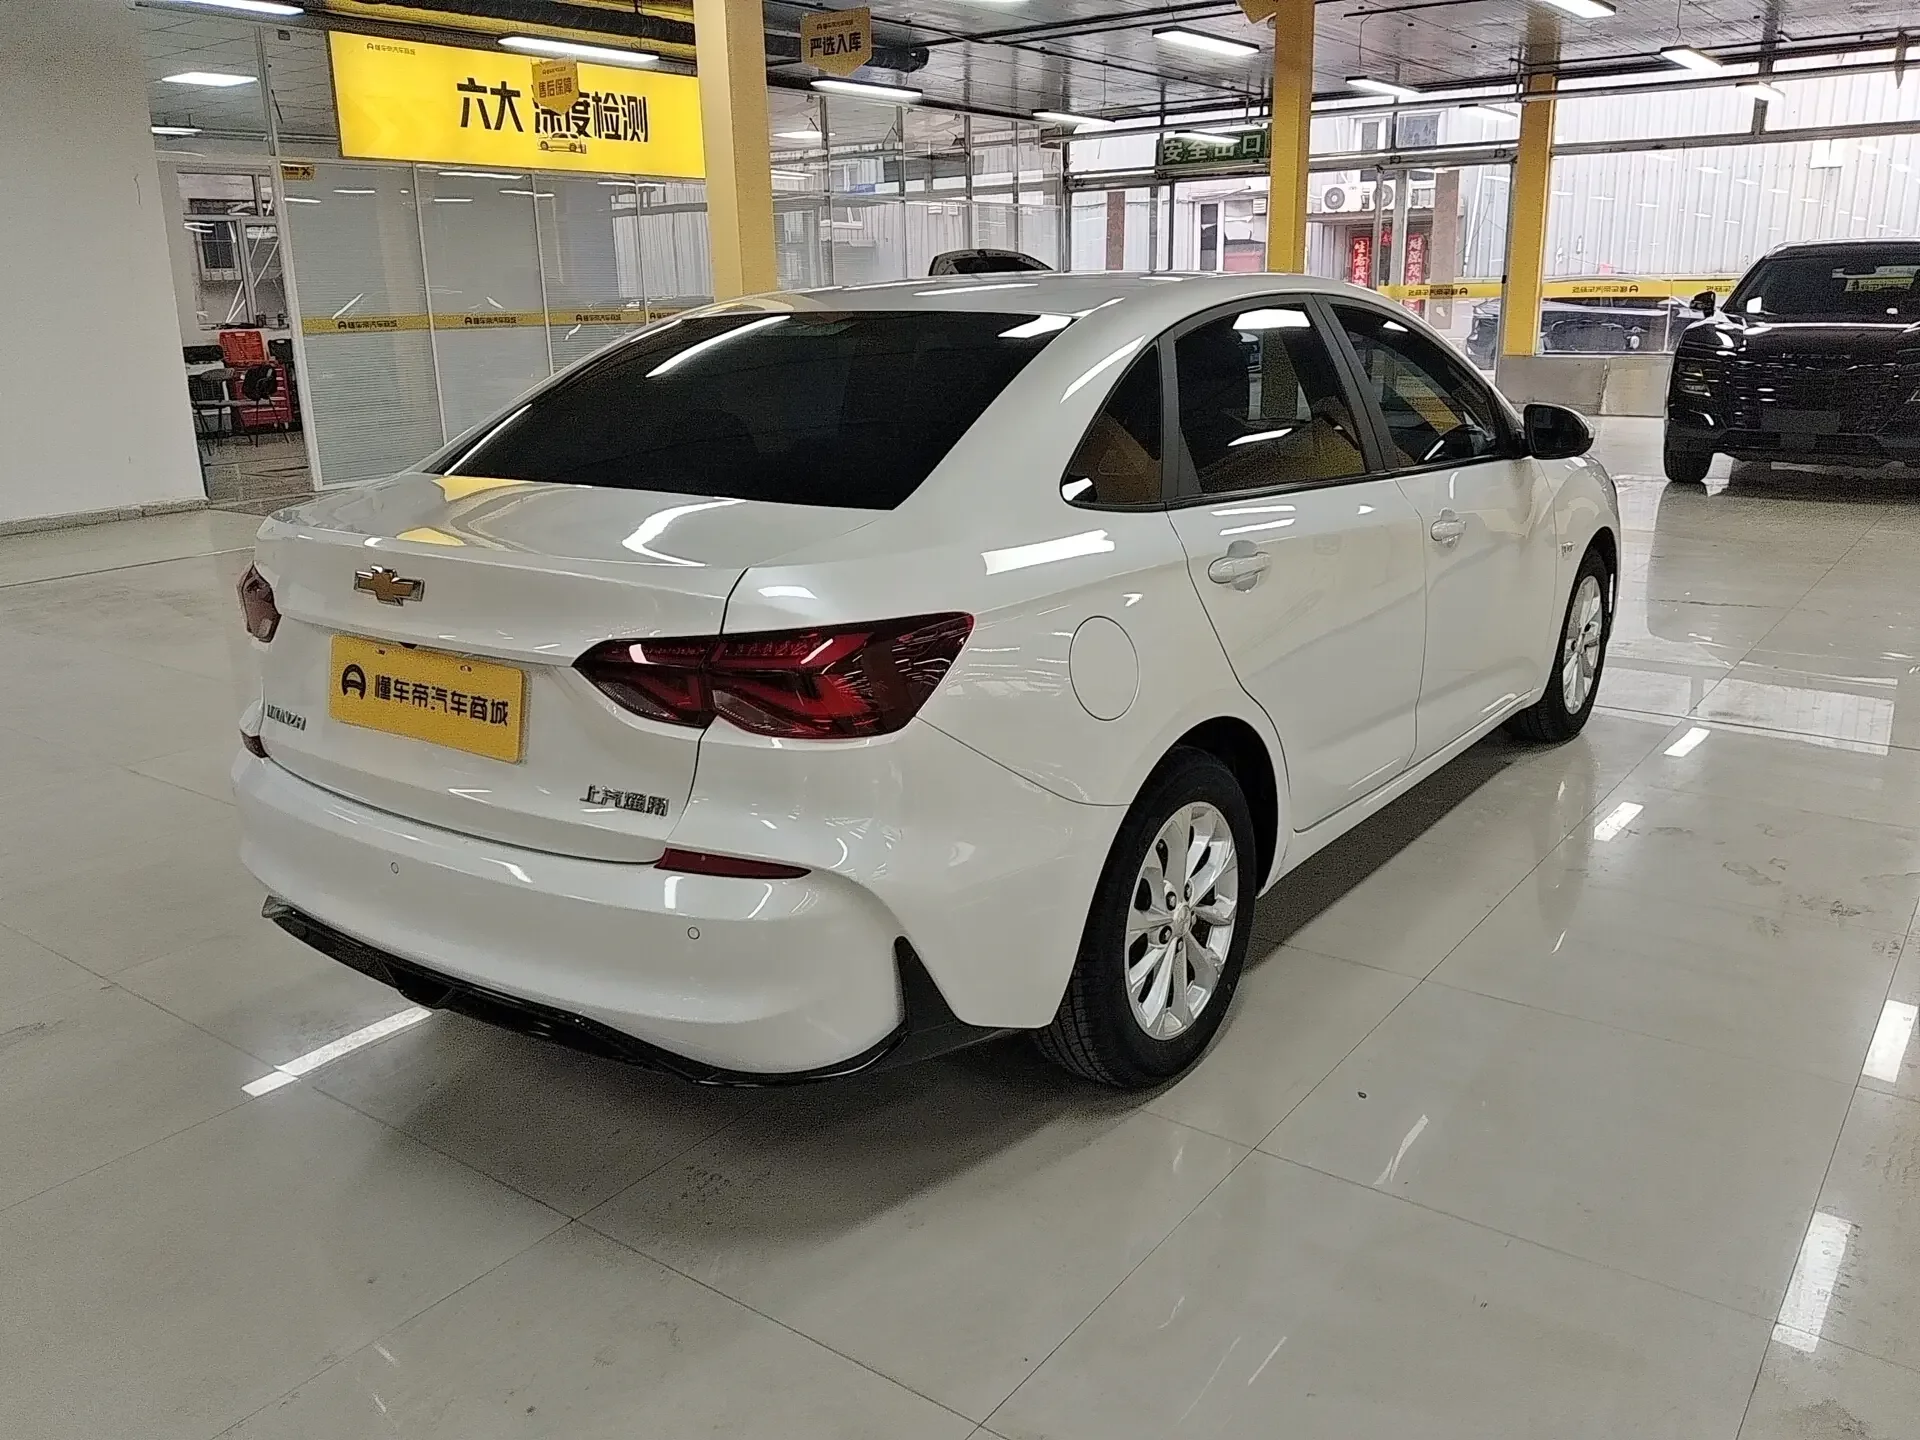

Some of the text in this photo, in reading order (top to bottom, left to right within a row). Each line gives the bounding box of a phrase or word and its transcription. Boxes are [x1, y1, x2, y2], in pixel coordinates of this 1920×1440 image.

[809, 31, 862, 58] 严选入库
[538, 77, 573, 98] 售后保障
[1164, 134, 1261, 163] 安全出口
[374, 674, 508, 727] 懂车帝汽车商城
[579, 784, 669, 817] 上汽通用
